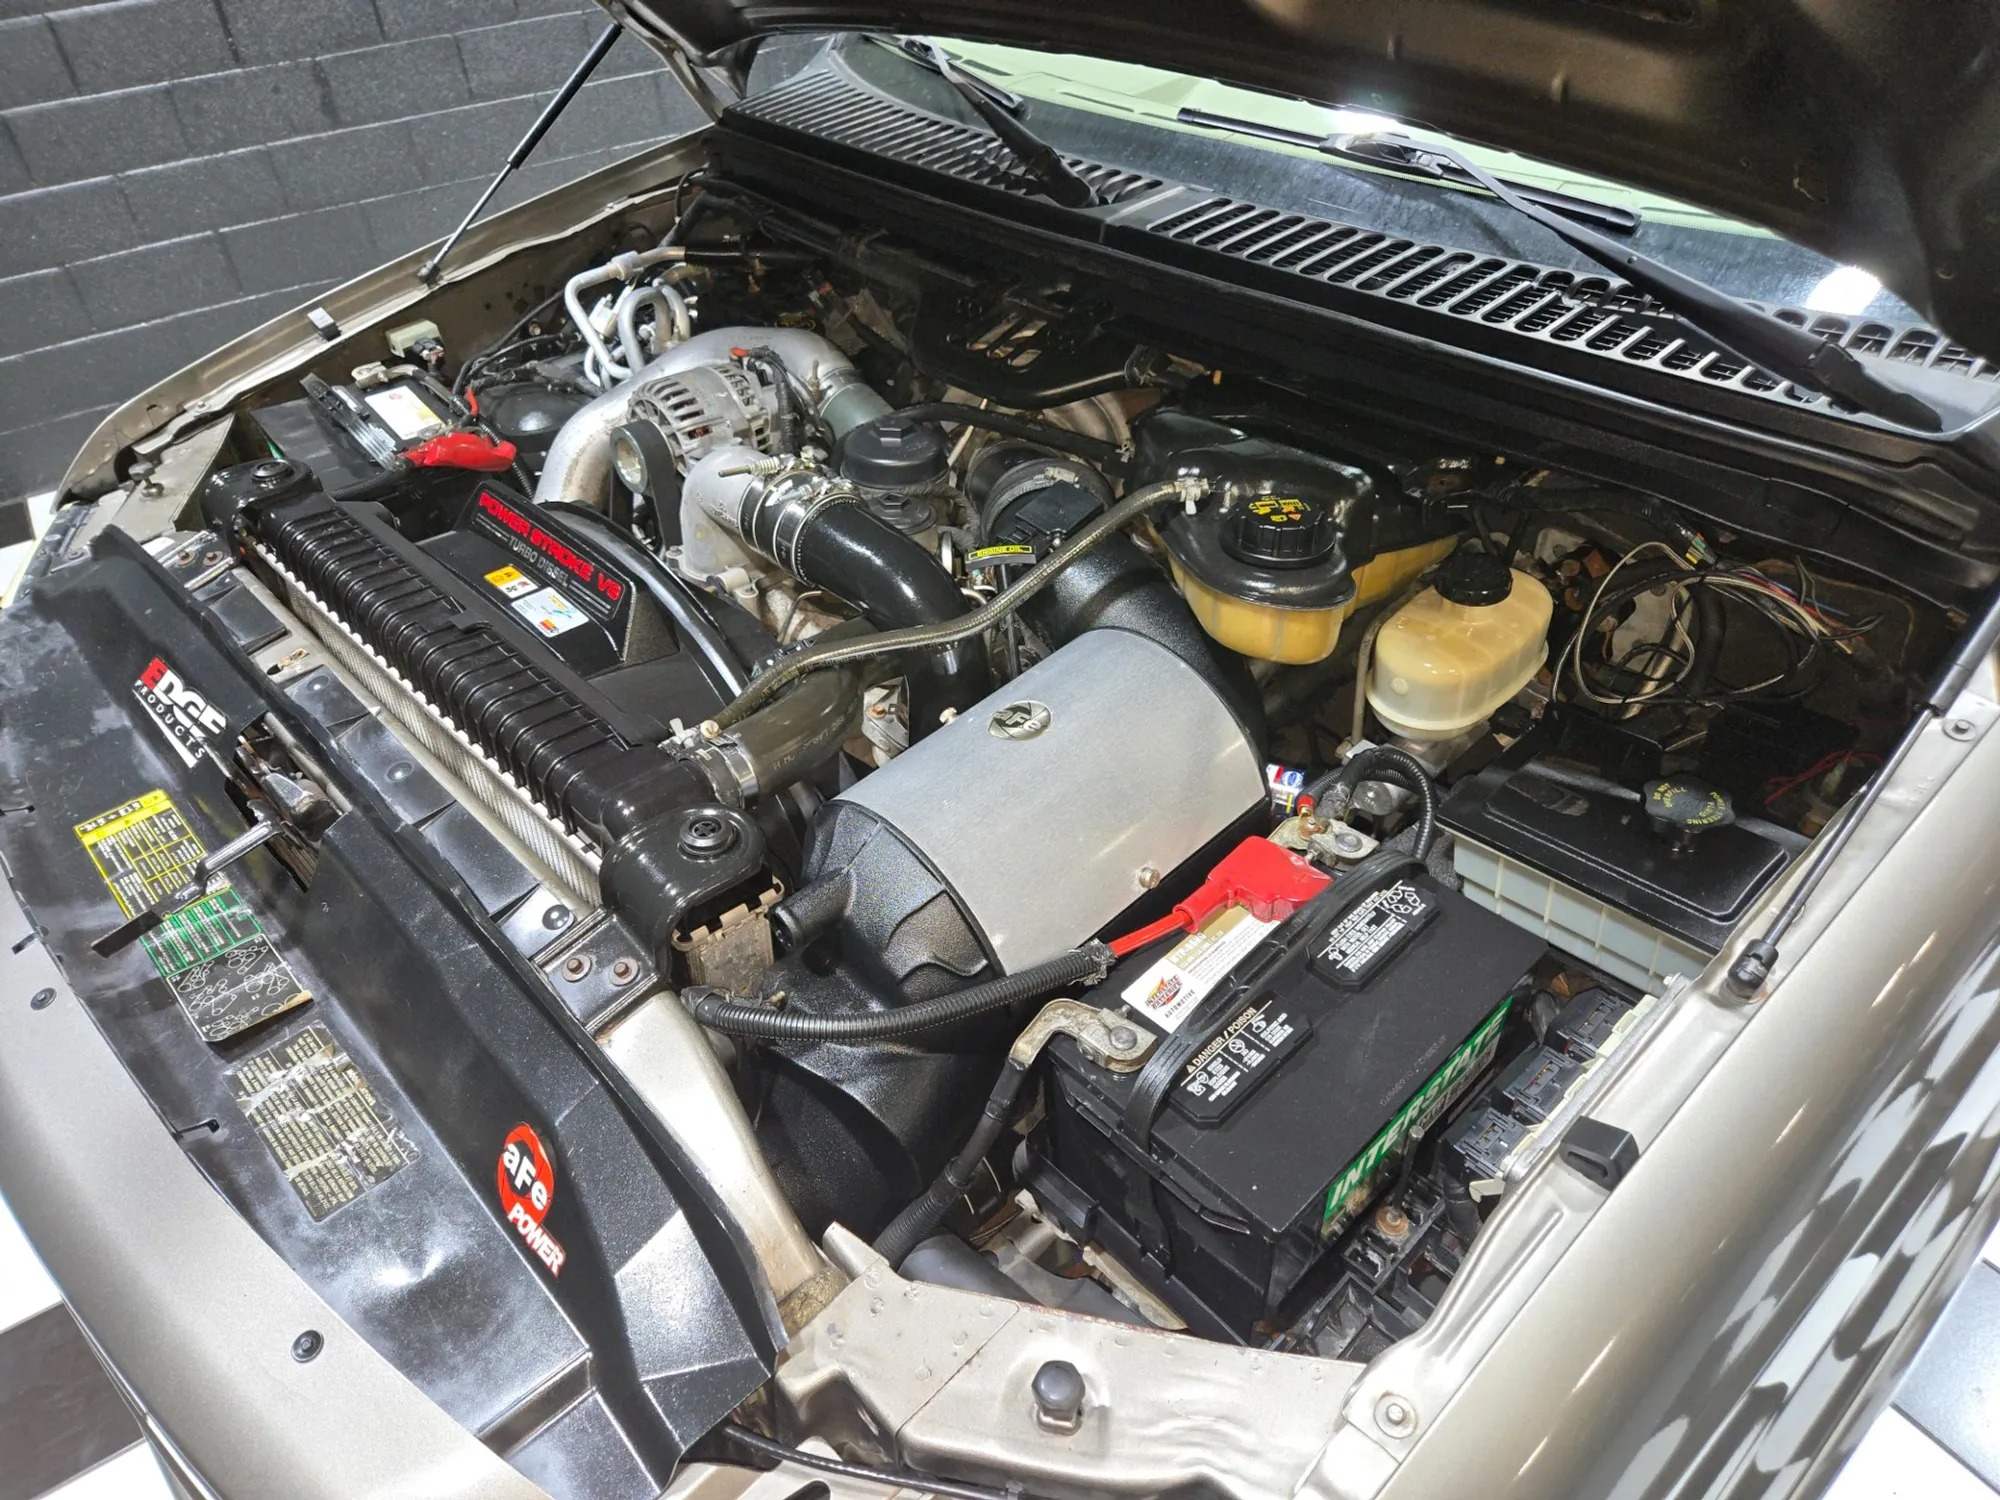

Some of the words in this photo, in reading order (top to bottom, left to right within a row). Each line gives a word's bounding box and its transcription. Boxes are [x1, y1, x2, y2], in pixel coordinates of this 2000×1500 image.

[478, 492, 531, 537] POWER
[529, 528, 595, 582] STROKE
[597, 572, 622, 601] V8
[508, 535, 538, 563] TURBO
[537, 556, 569, 587] DIESEL
[134, 680, 205, 760] PRODUCTS
[138, 656, 228, 742] EDGE
[995, 710, 1042, 732] aFe
[1145, 974, 1179, 1006] INTERSTATE
[1164, 989, 1195, 1018] AUTOMOTIVE
[1192, 1035, 1224, 1067] DANGER
[1227, 1006, 1256, 1034] POISON
[1330, 1007, 1508, 1207] INTERSTATE
[501, 1141, 549, 1211] aFe
[507, 1203, 566, 1276] POWER
